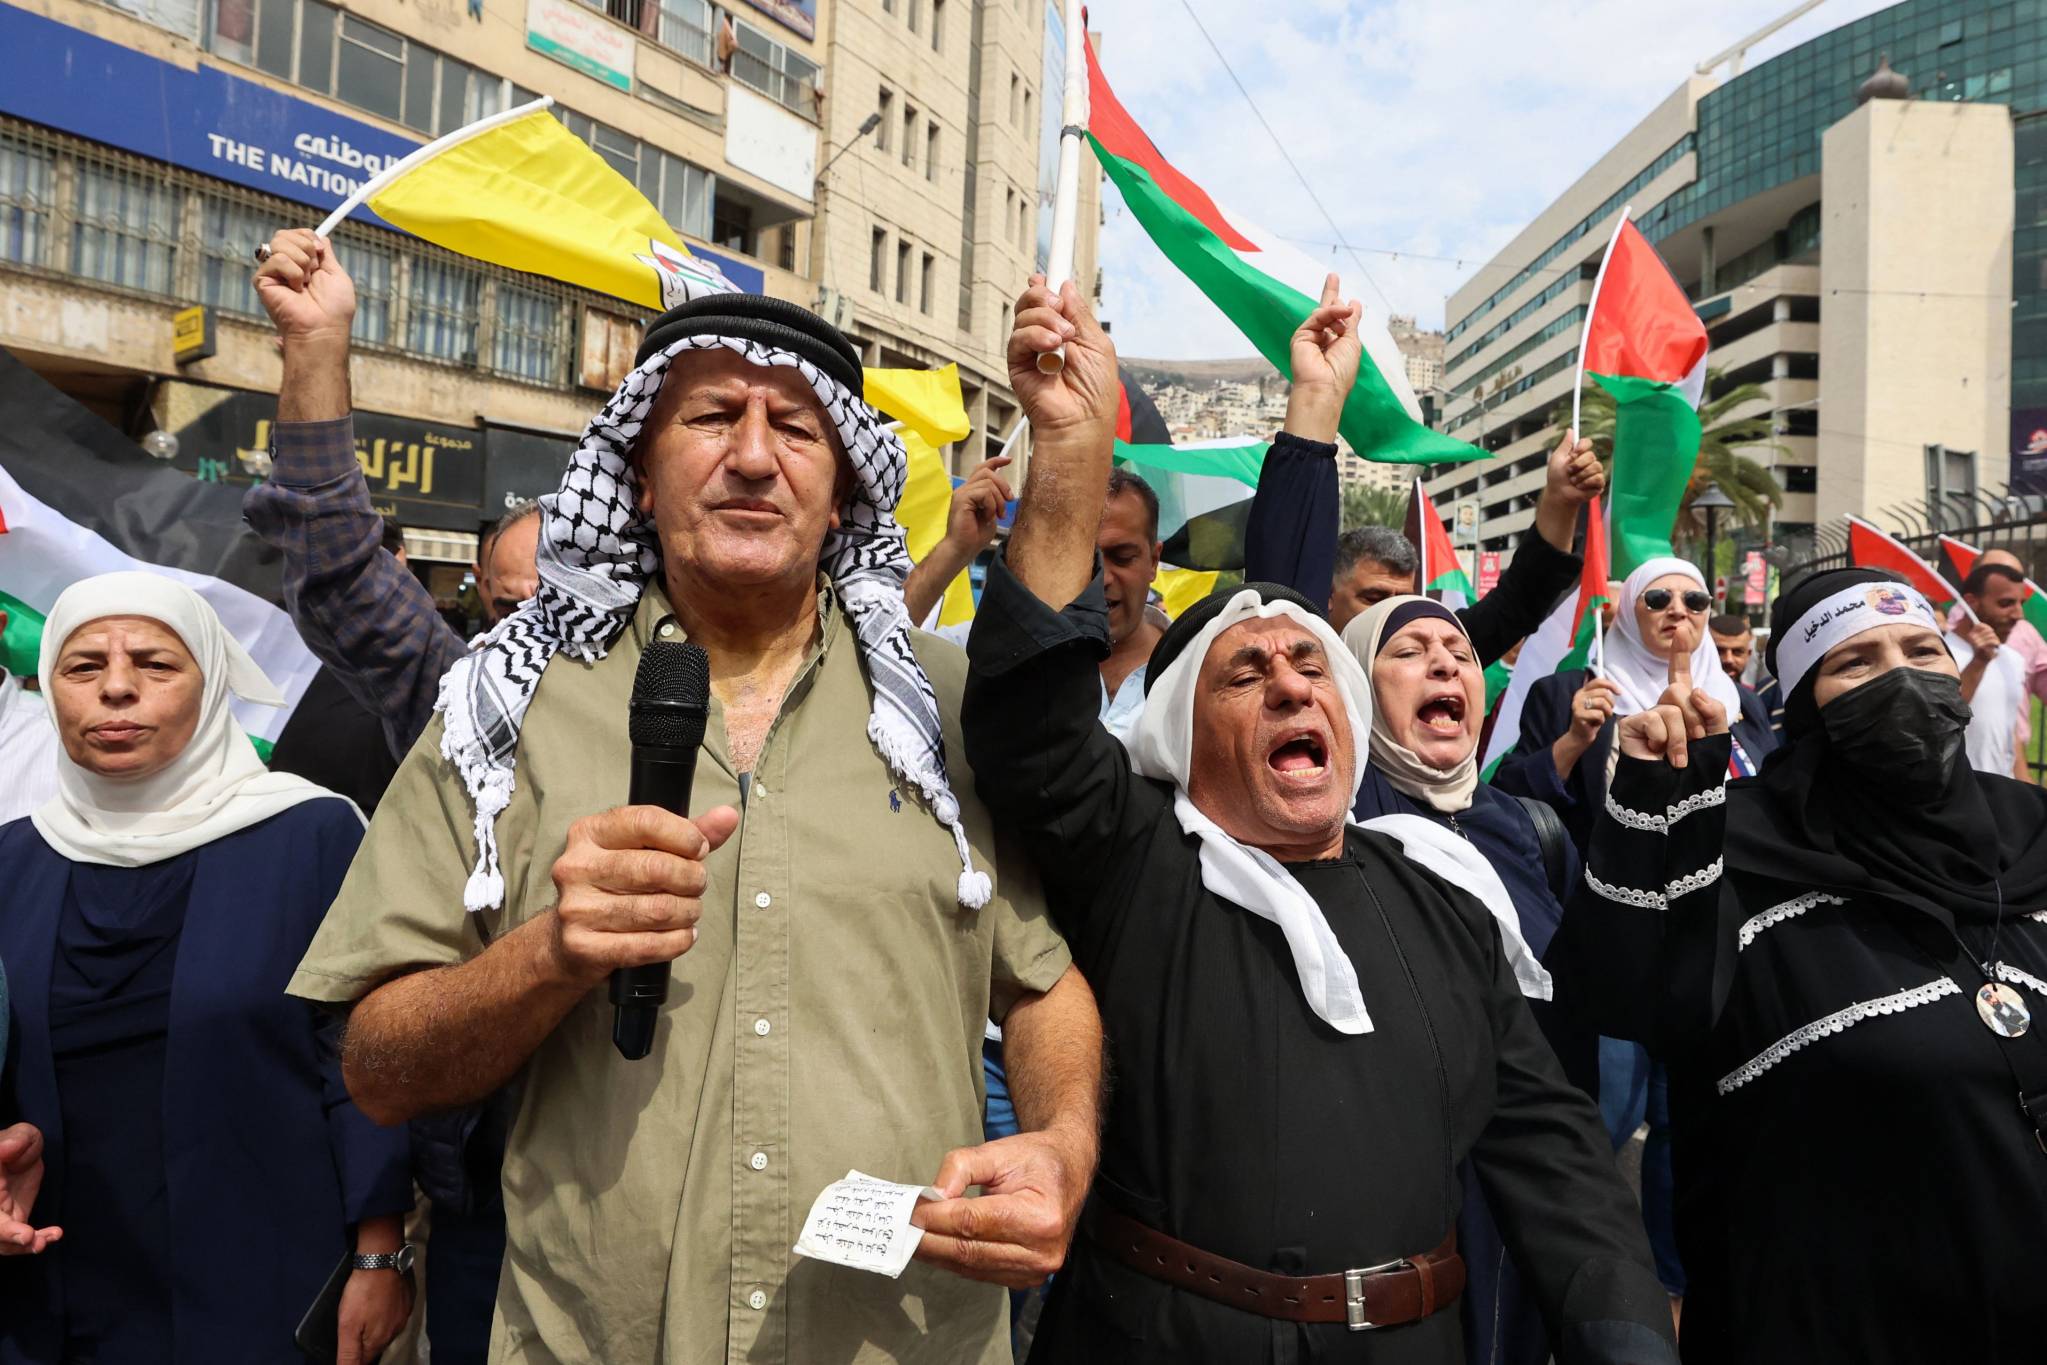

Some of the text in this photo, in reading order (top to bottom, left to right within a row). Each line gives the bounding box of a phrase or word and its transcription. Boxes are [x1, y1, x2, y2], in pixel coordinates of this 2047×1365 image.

[208, 133, 265, 171] THE
[294, 132, 400, 178] لوطني
[424, 432, 472, 449] مجموعة
[1804, 599, 1866, 643] محمد الدخيل
[866, 1242, 887, 1257] تاريخ
